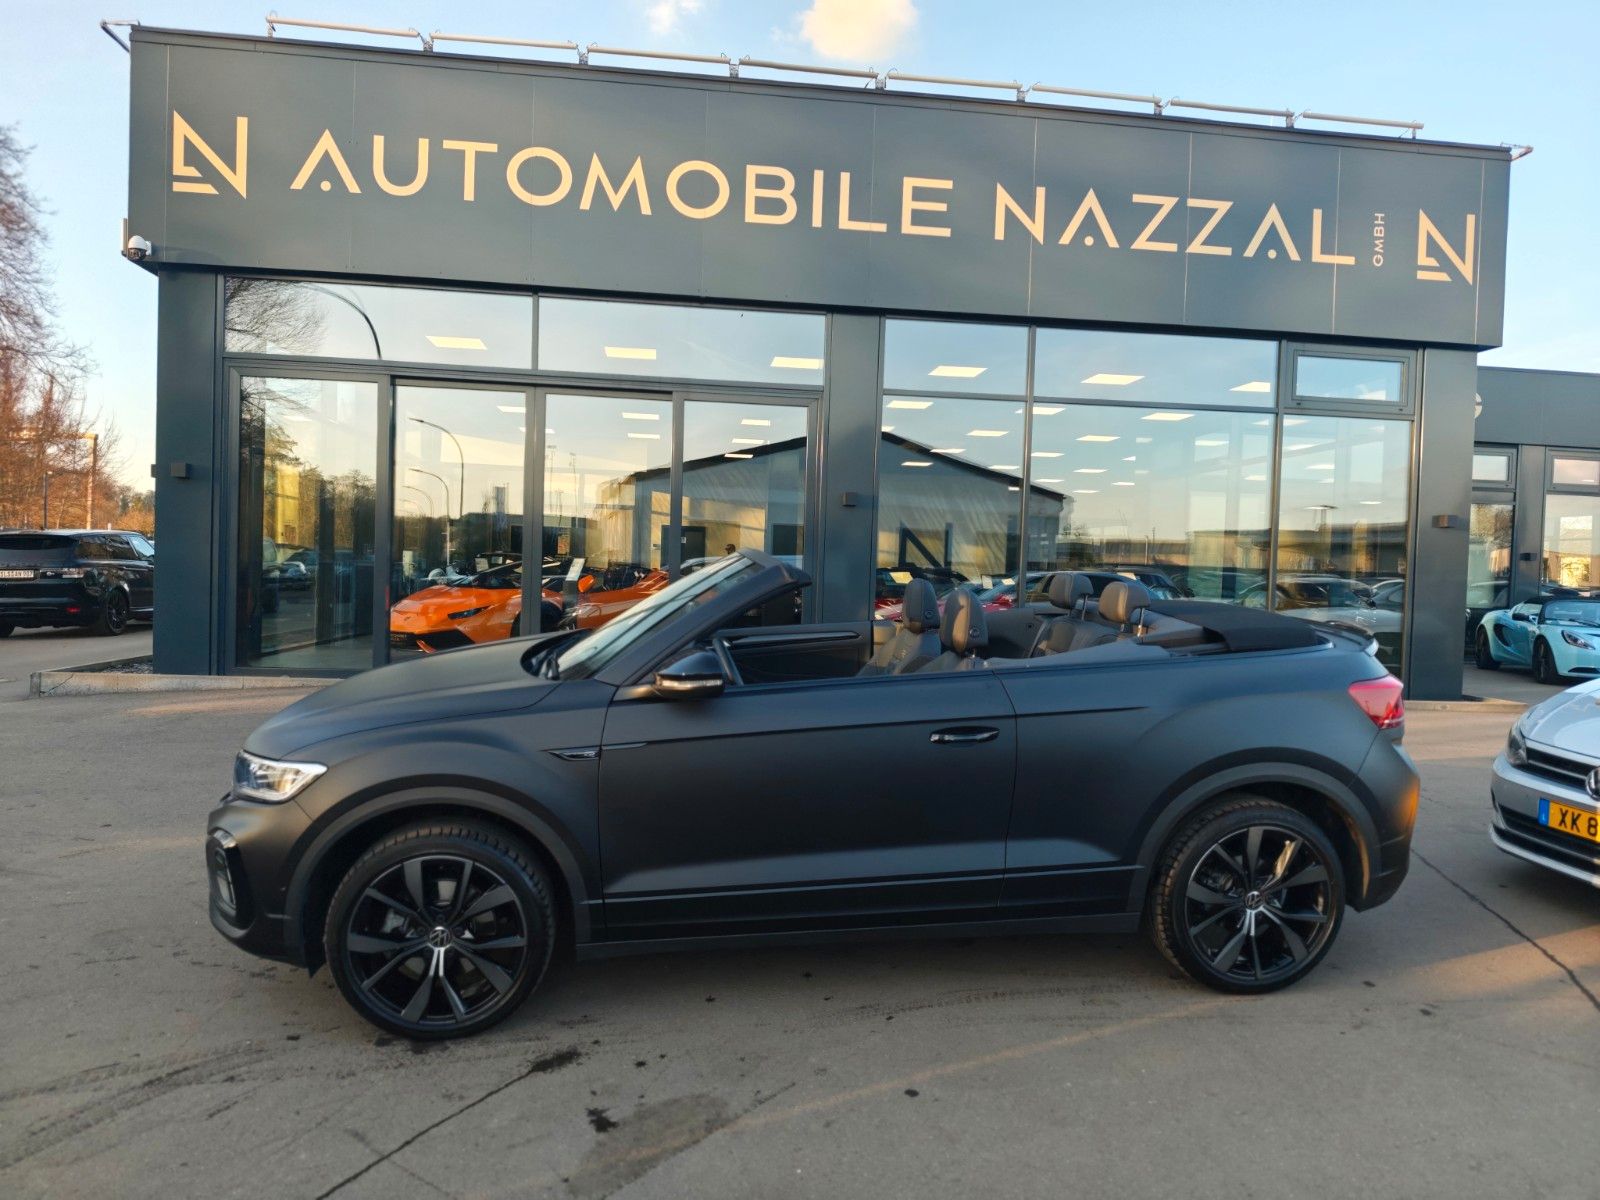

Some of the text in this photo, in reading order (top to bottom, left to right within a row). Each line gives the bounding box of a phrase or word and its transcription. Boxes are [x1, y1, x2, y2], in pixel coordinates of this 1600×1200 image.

[289, 128, 1356, 266] AUTOMOBILE NAZZAL
[1373, 213, 1385, 267] GMBH
[1559, 807, 1581, 833] XK
